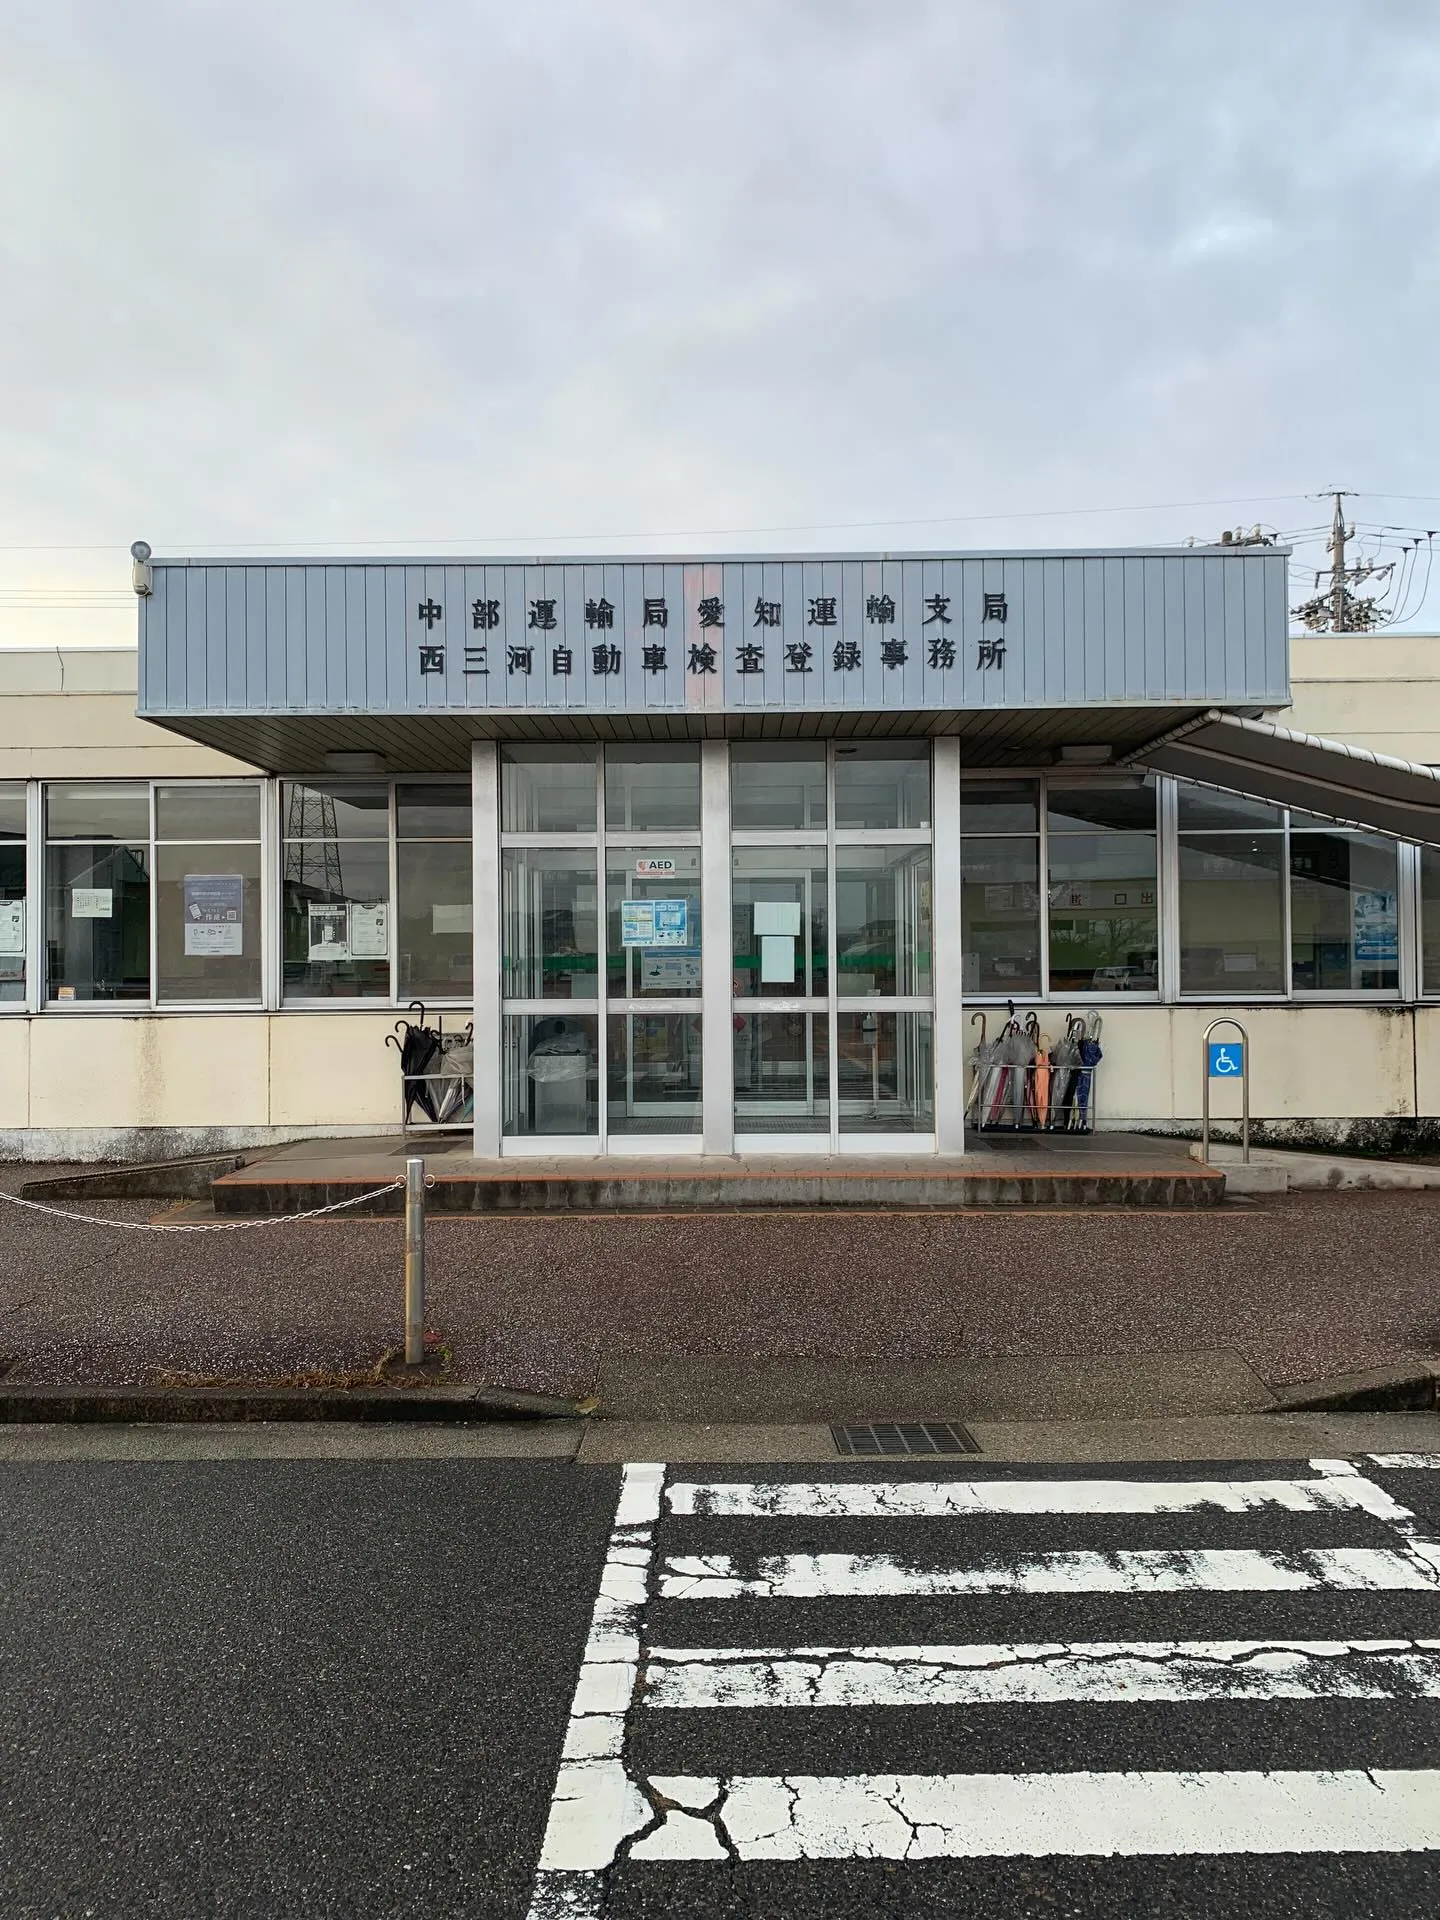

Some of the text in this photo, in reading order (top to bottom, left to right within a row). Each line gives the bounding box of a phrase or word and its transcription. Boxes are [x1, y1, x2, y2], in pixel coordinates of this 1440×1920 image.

[418, 592, 1008, 630] 中部運輸局愛知運輸支局
[418, 638, 1007, 675] 西三河自動車検査登録事務所
[649, 861, 672, 869] AED
